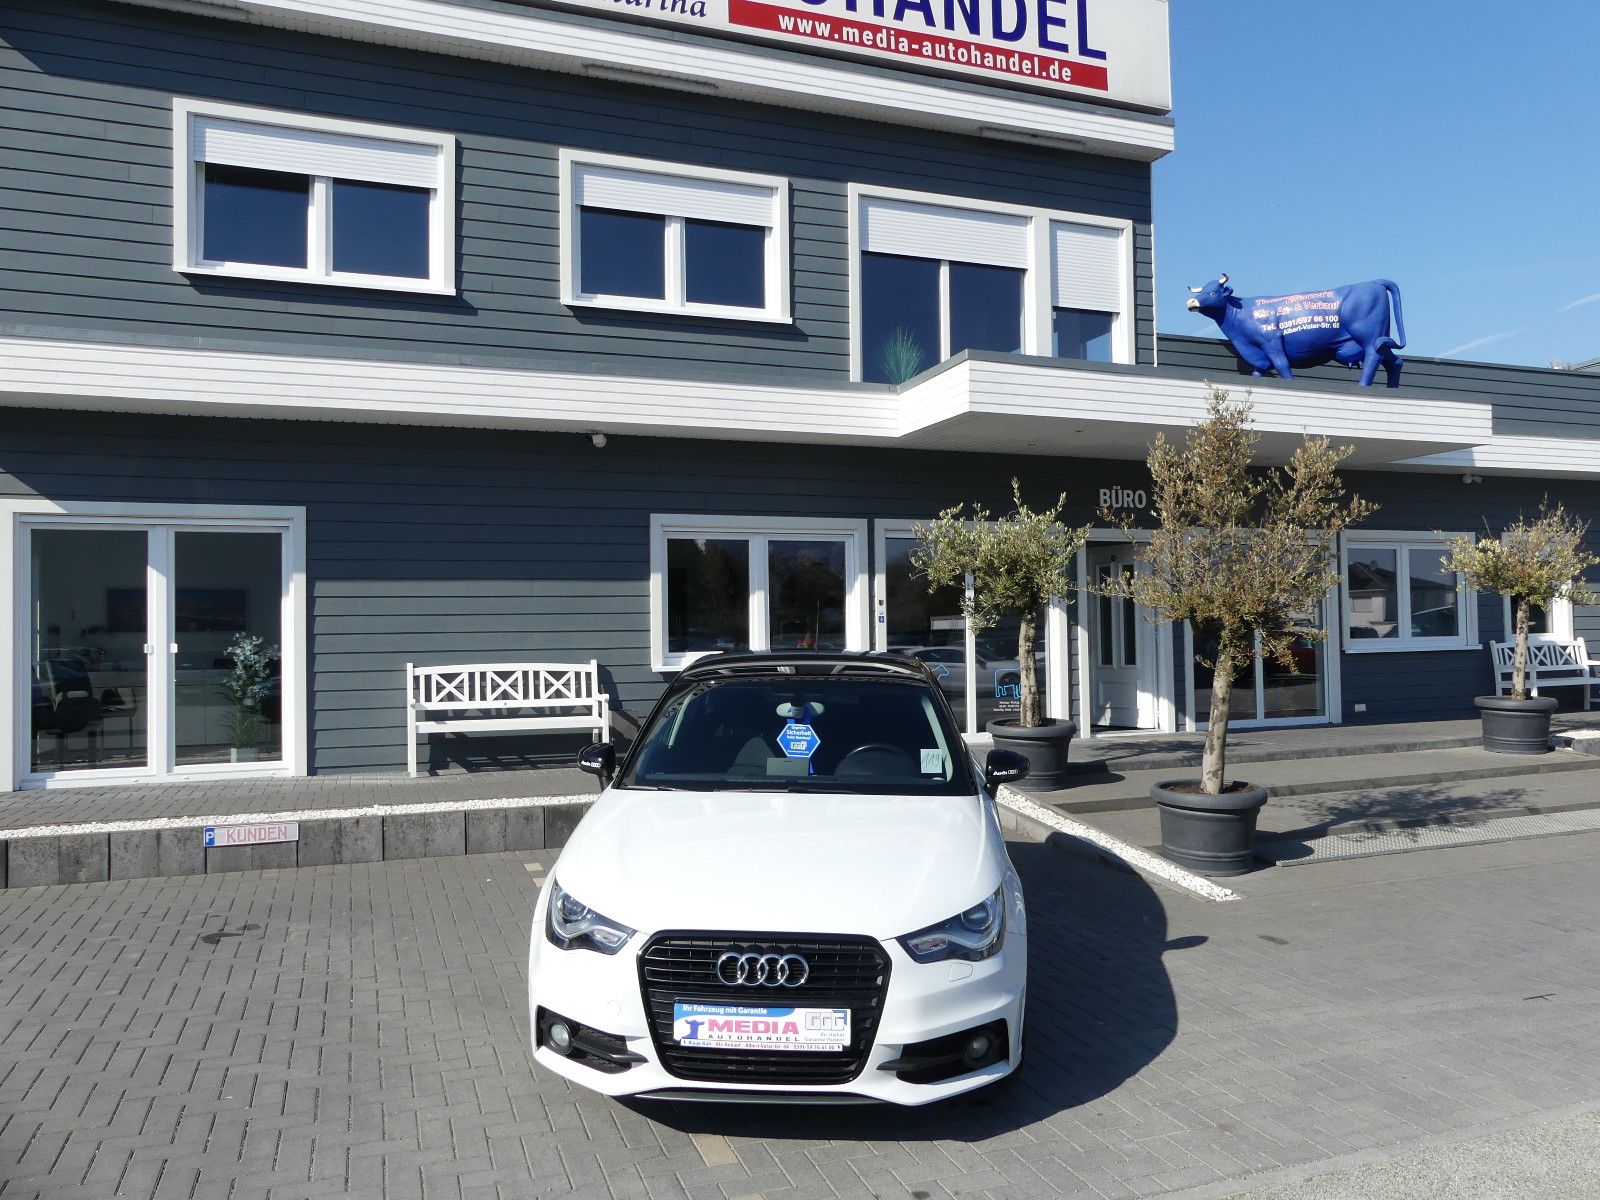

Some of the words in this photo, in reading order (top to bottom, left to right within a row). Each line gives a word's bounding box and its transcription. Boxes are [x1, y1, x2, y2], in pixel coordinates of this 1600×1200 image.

[778, 14, 1072, 82] www.media-autohandel.de
[1325, 315, 1339, 323] 100
[1099, 486, 1147, 508] BÜRO
[226, 826, 288, 843] KUNDEN
[694, 1005, 724, 1015] Fahrzeug
[708, 1018, 799, 1035] MEDIA
[708, 1034, 800, 1042] AUTOHANDEL
